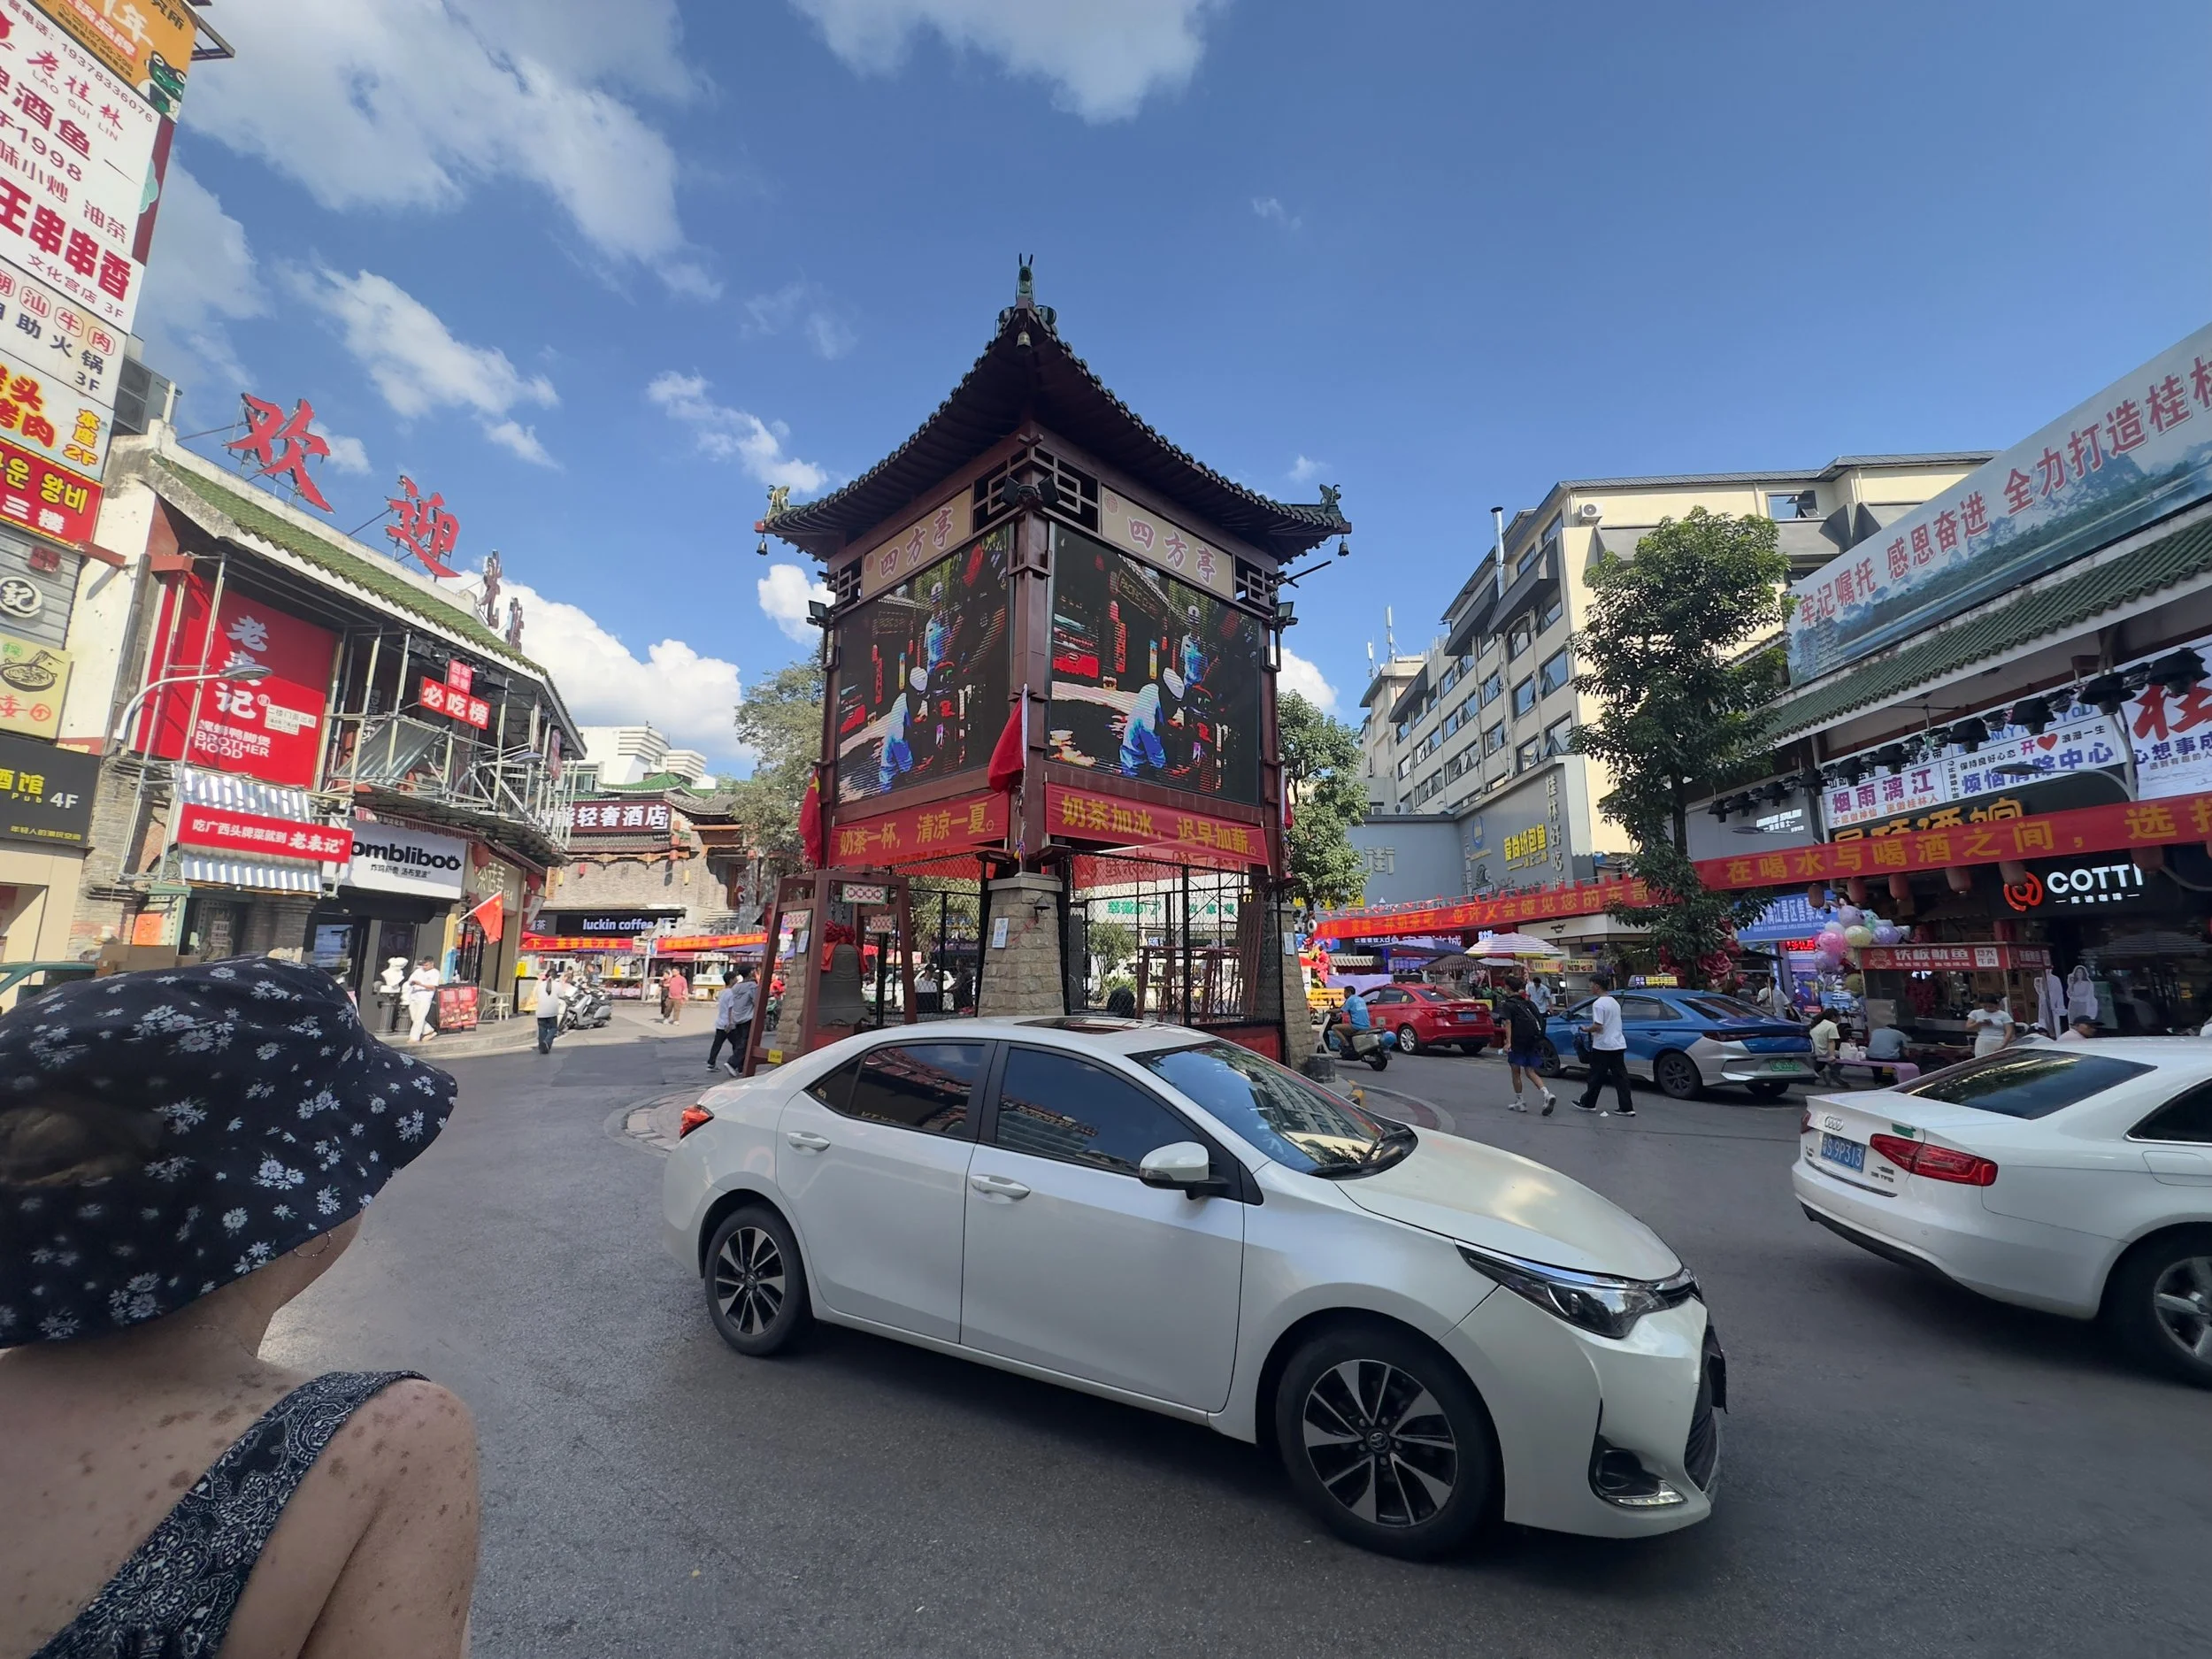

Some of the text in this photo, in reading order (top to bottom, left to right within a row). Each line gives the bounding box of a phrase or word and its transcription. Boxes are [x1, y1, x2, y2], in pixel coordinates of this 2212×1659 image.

[26, 50, 124, 132] 老桂林
[32, 70, 119, 142] LAO GUI LIN
[61, 42, 153, 123] 19378336076
[84, 199, 127, 244] 油茶
[27, 253, 124, 319] 文化宫店 3F
[0, 303, 104, 375] 助火锅
[0, 363, 42, 412] 头
[74, 371, 101, 392] 3F
[62, 444, 99, 466] 2F
[0, 451, 88, 516] 운 왕비
[221, 392, 461, 578] 欢迎
[878, 506, 955, 579] 四方亭
[1127, 515, 1218, 586] 四方亭
[1799, 555, 1877, 628] 牢记嘱托
[1885, 489, 1991, 582] 感恩奋进
[423, 684, 489, 726] 必吃榜
[193, 739, 244, 759] HOOD
[195, 731, 270, 758] BROTHER
[1960, 725, 2107, 772] 保持良好心态 开 浪漫一生
[50, 792, 79, 809] 4F
[1832, 768, 1935, 814] 烟雨漓江
[191, 818, 288, 844] 吃广西头牌菜就到
[840, 802, 995, 857] 奶茶一杯，清凉一夏。
[1061, 795, 1257, 856] 奶茶加冰，迟早加薪。
[1363, 846, 1395, 875] 街
[2047, 863, 2144, 895] COTTI
[582, 918, 654, 931] luckin coffee
